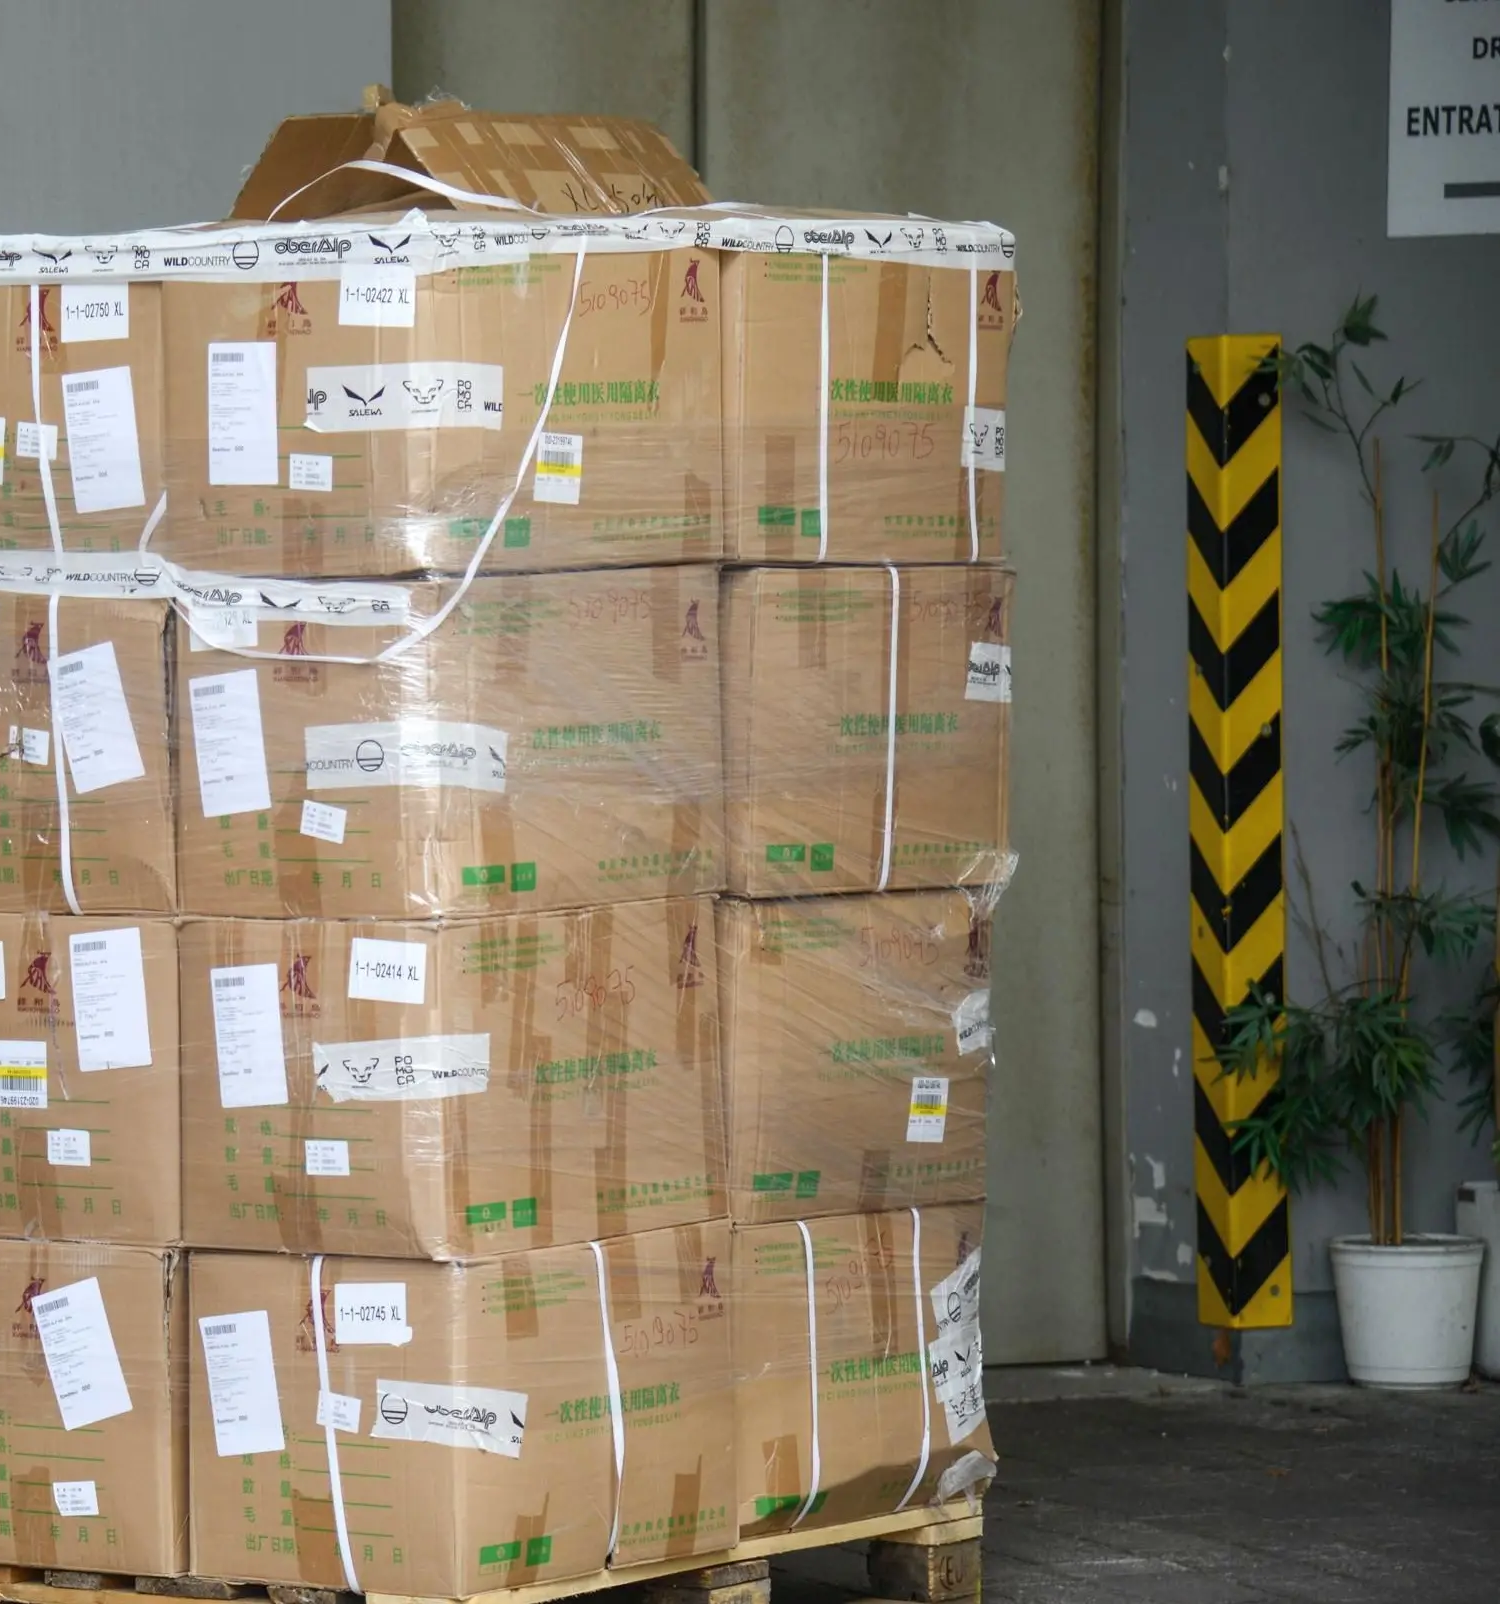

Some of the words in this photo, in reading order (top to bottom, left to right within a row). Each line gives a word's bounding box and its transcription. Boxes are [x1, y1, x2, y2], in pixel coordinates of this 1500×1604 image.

[274, 236, 351, 259] oberAlp
[163, 250, 231, 267] WILDCOUNTRY
[373, 255, 410, 264] SALEWA
[346, 287, 393, 304] 1-1-02422
[398, 288, 409, 304] XL
[579, 280, 650, 317] 5109075
[66, 303, 109, 319] 1-1-02750
[114, 301, 124, 316] XL
[457, 379, 472, 390] PO
[457, 390, 472, 400] MO
[457, 400, 472, 411] CA
[349, 409, 382, 417] SALEWA
[835, 422, 936, 464] 5109075
[65, 573, 131, 582] WILDCOUNTRY
[306, 758, 355, 771] COUNTRY
[355, 961, 402, 980] 1-1-02414
[407, 966, 419, 981] XL
[394, 1055, 412, 1066] PO
[396, 1075, 416, 1086] CA
[339, 1305, 386, 1321] 1-1-02745
[391, 1306, 401, 1321] XL
